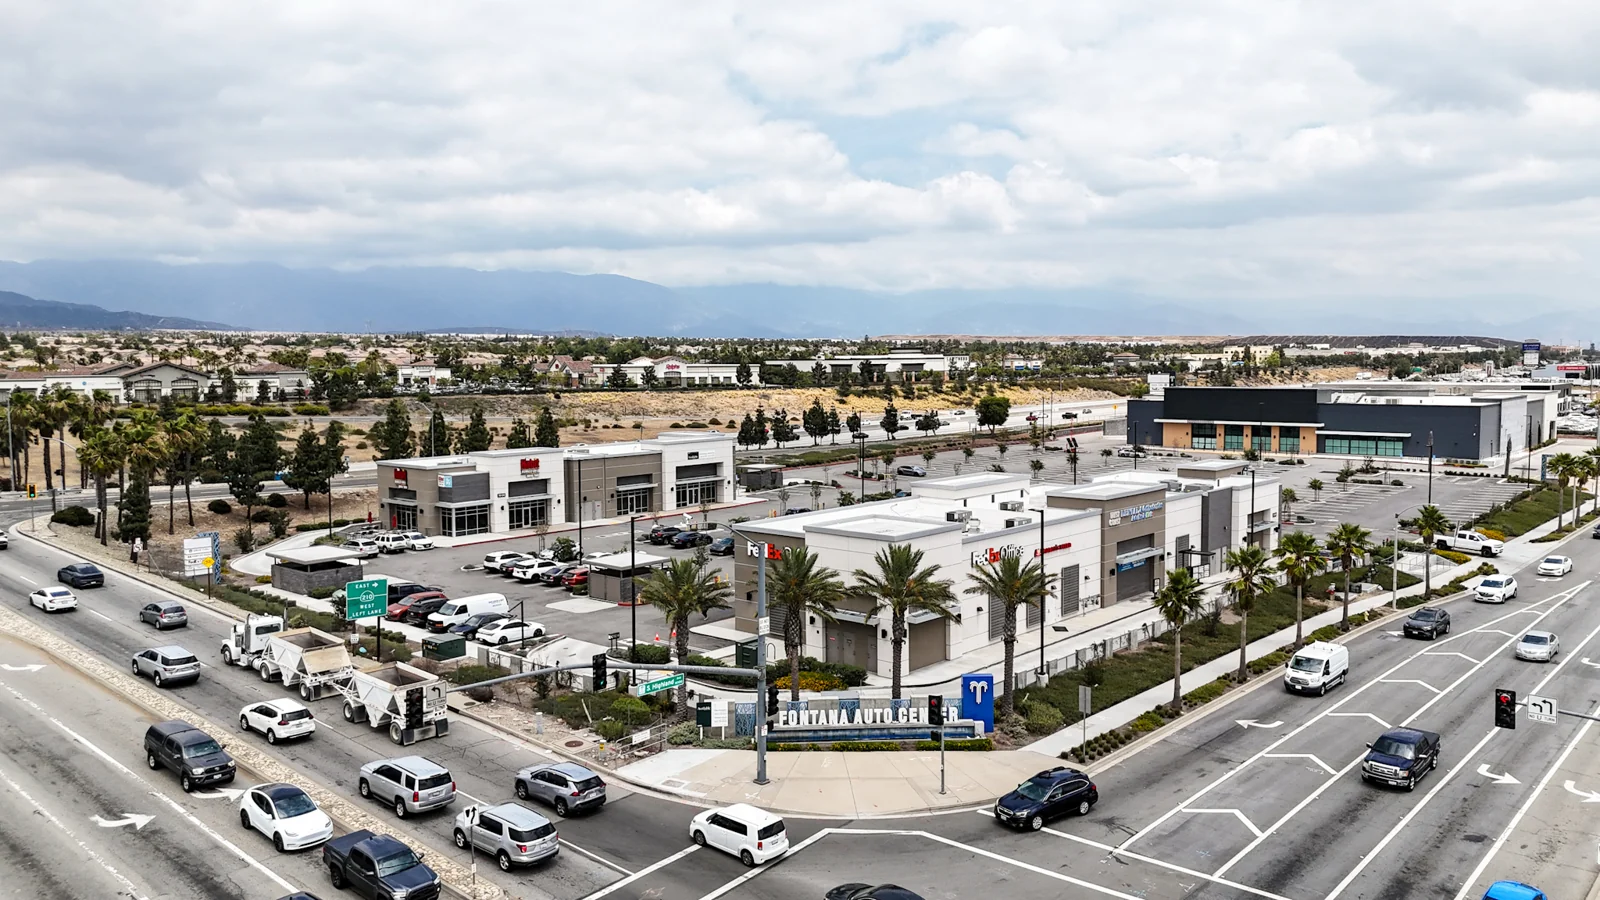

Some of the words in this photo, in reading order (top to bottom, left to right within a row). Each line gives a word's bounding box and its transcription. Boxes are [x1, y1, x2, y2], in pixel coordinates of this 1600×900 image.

[651, 679, 675, 690] Highland
[779, 708, 849, 727] FONTANA
[853, 708, 893, 725] AUTO
[898, 707, 959, 724] CENER
